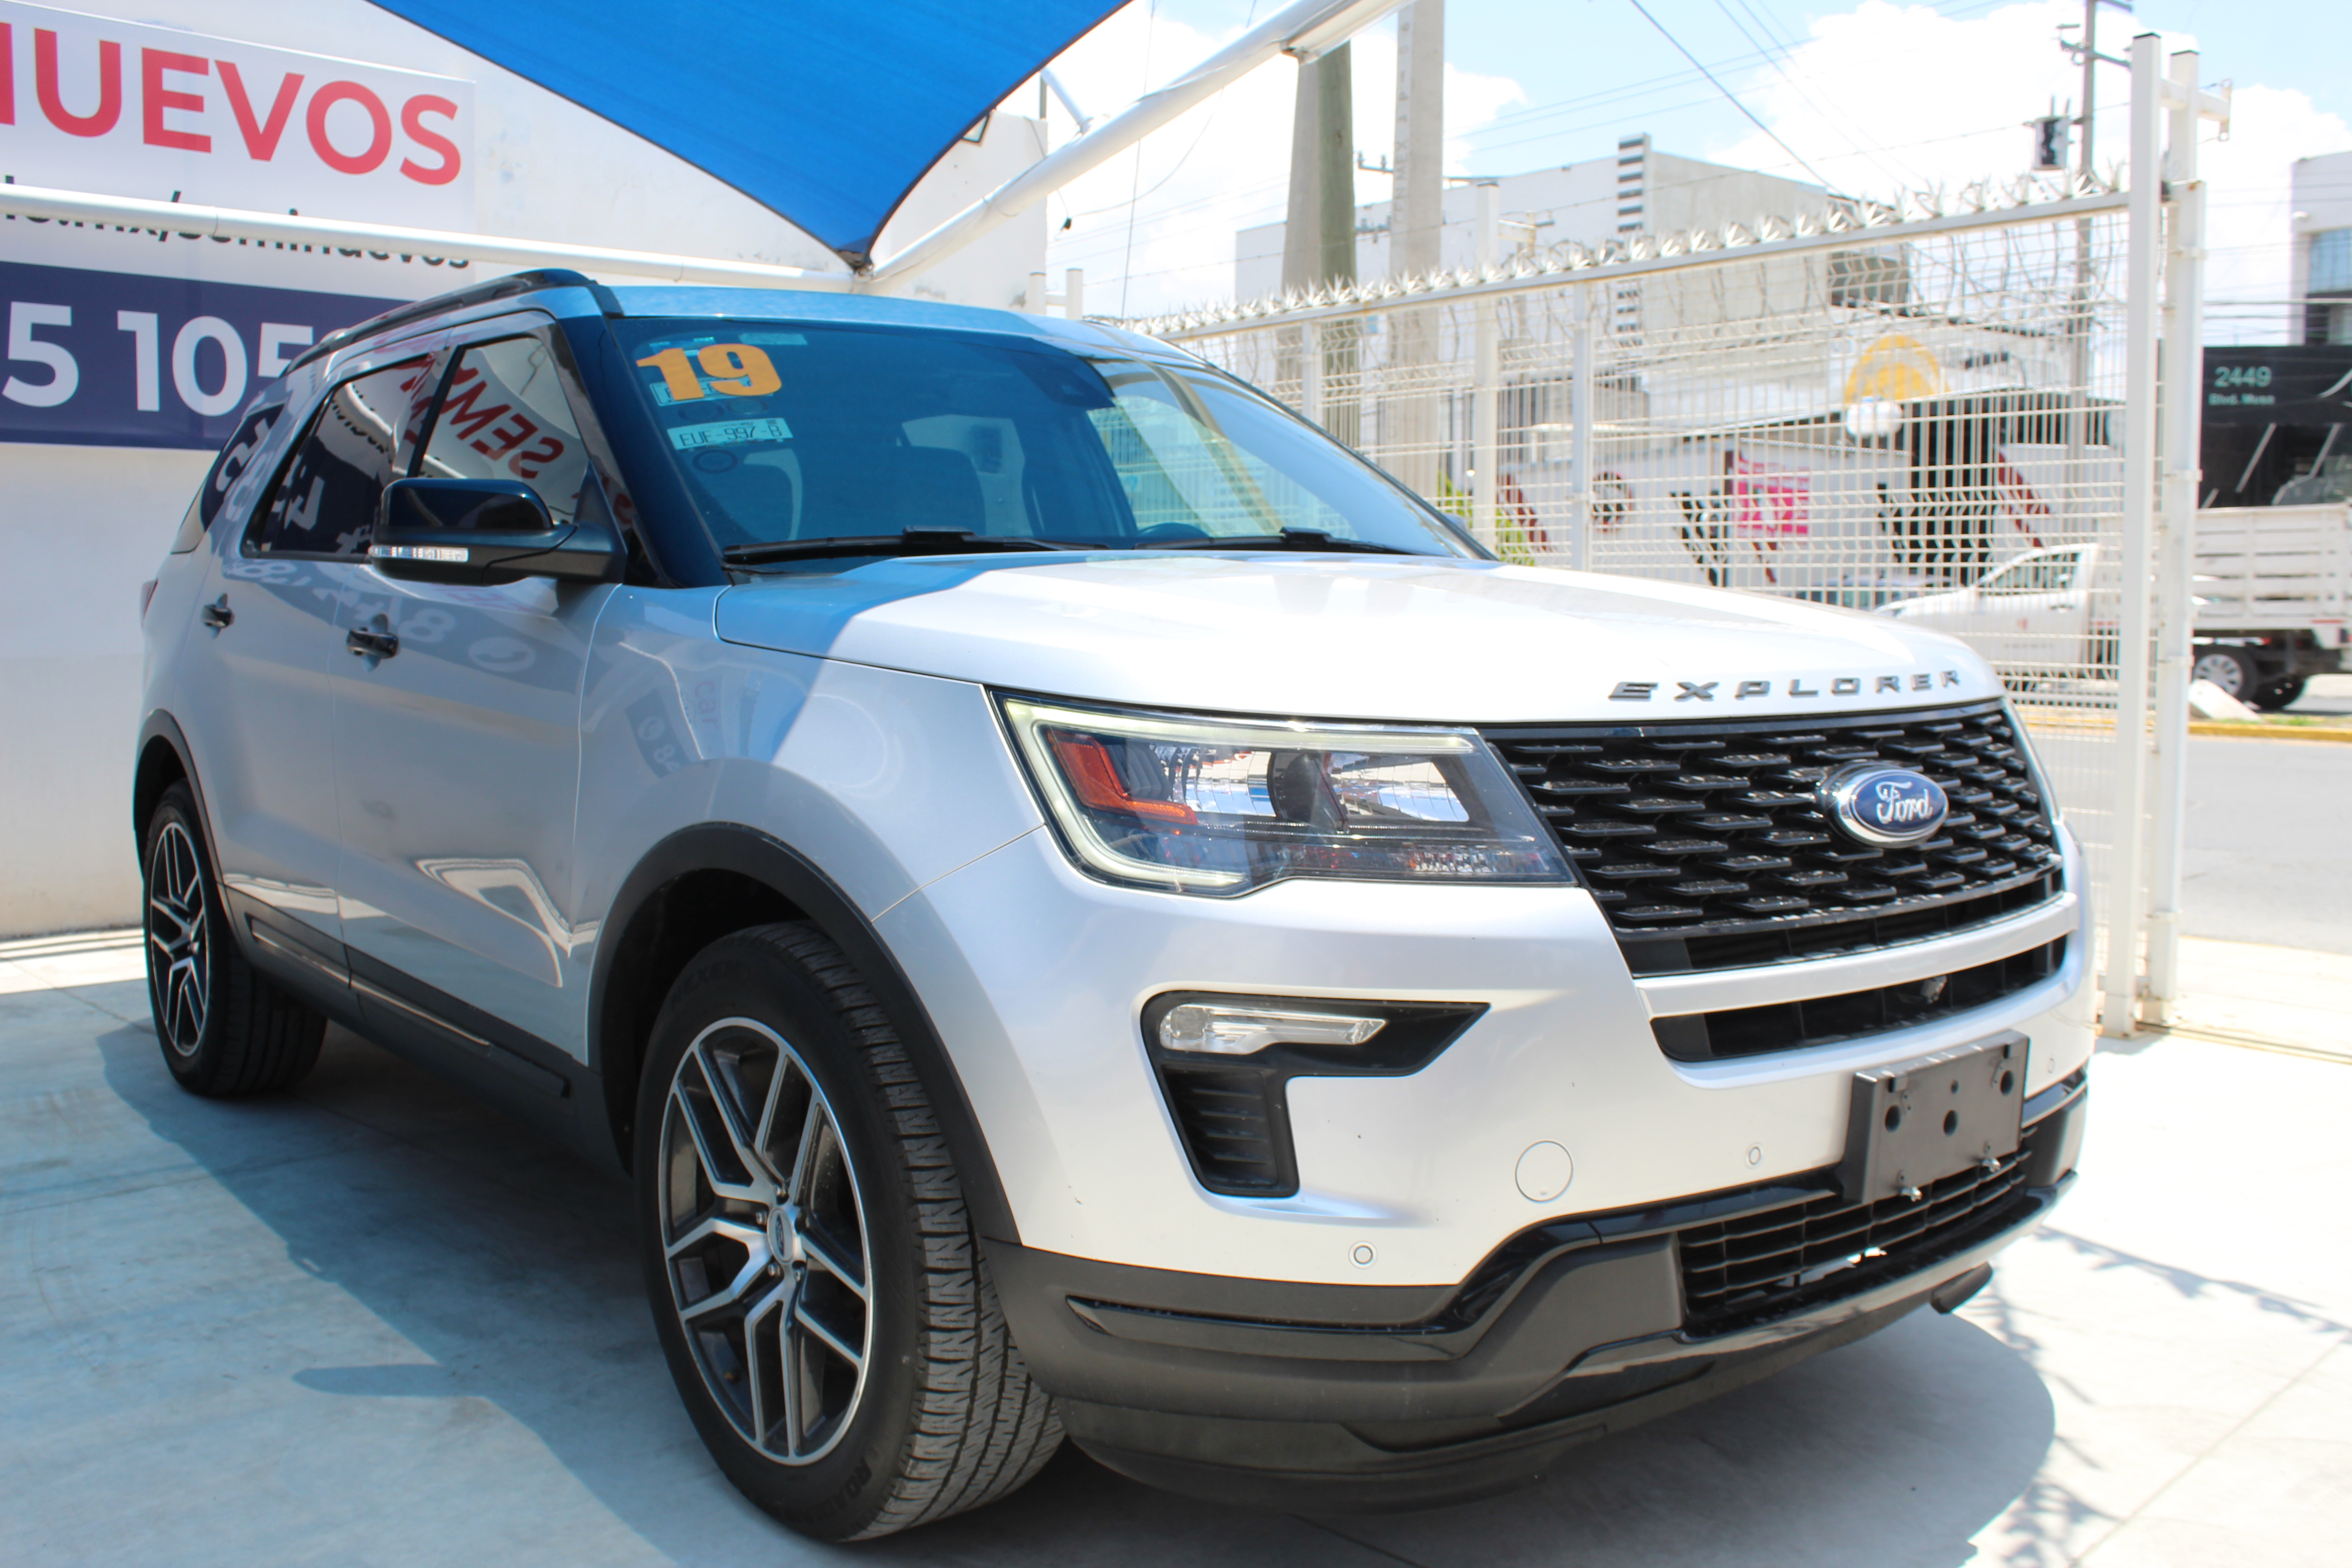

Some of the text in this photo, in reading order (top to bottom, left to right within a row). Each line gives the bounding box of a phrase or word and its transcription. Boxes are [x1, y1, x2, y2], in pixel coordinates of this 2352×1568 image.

[0, 23, 461, 185] UEVOS
[2, 301, 79, 407] 5
[637, 344, 781, 400] 19
[2214, 366, 2272, 387] 2449
[1609, 670, 1960, 700] EXPLORER
[1875, 781, 1933, 824] Ford
